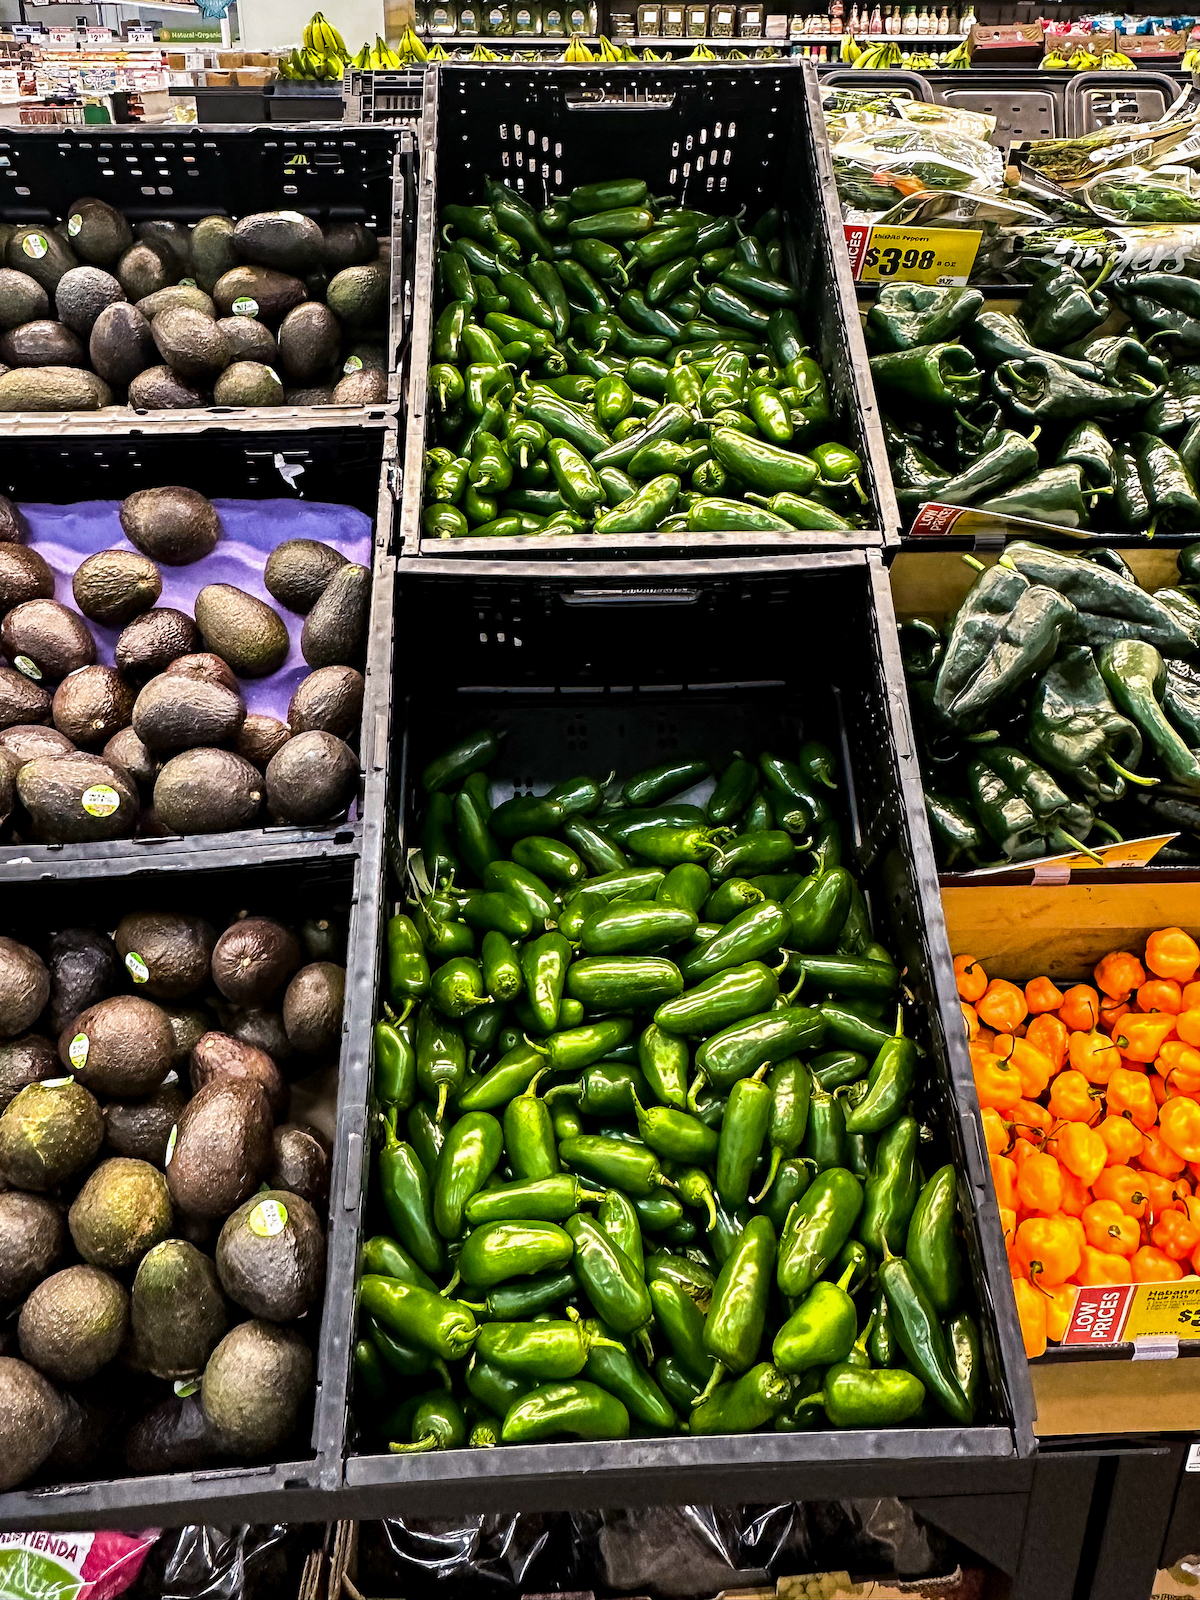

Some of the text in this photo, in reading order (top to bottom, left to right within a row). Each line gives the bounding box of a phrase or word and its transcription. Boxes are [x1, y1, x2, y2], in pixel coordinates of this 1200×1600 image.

[848, 231, 863, 268] RICES
[864, 246, 936, 276] $398
[918, 509, 939, 526] LOW
[1073, 1301, 1098, 1333] LOW
[1090, 1291, 1121, 1339] PRICES
